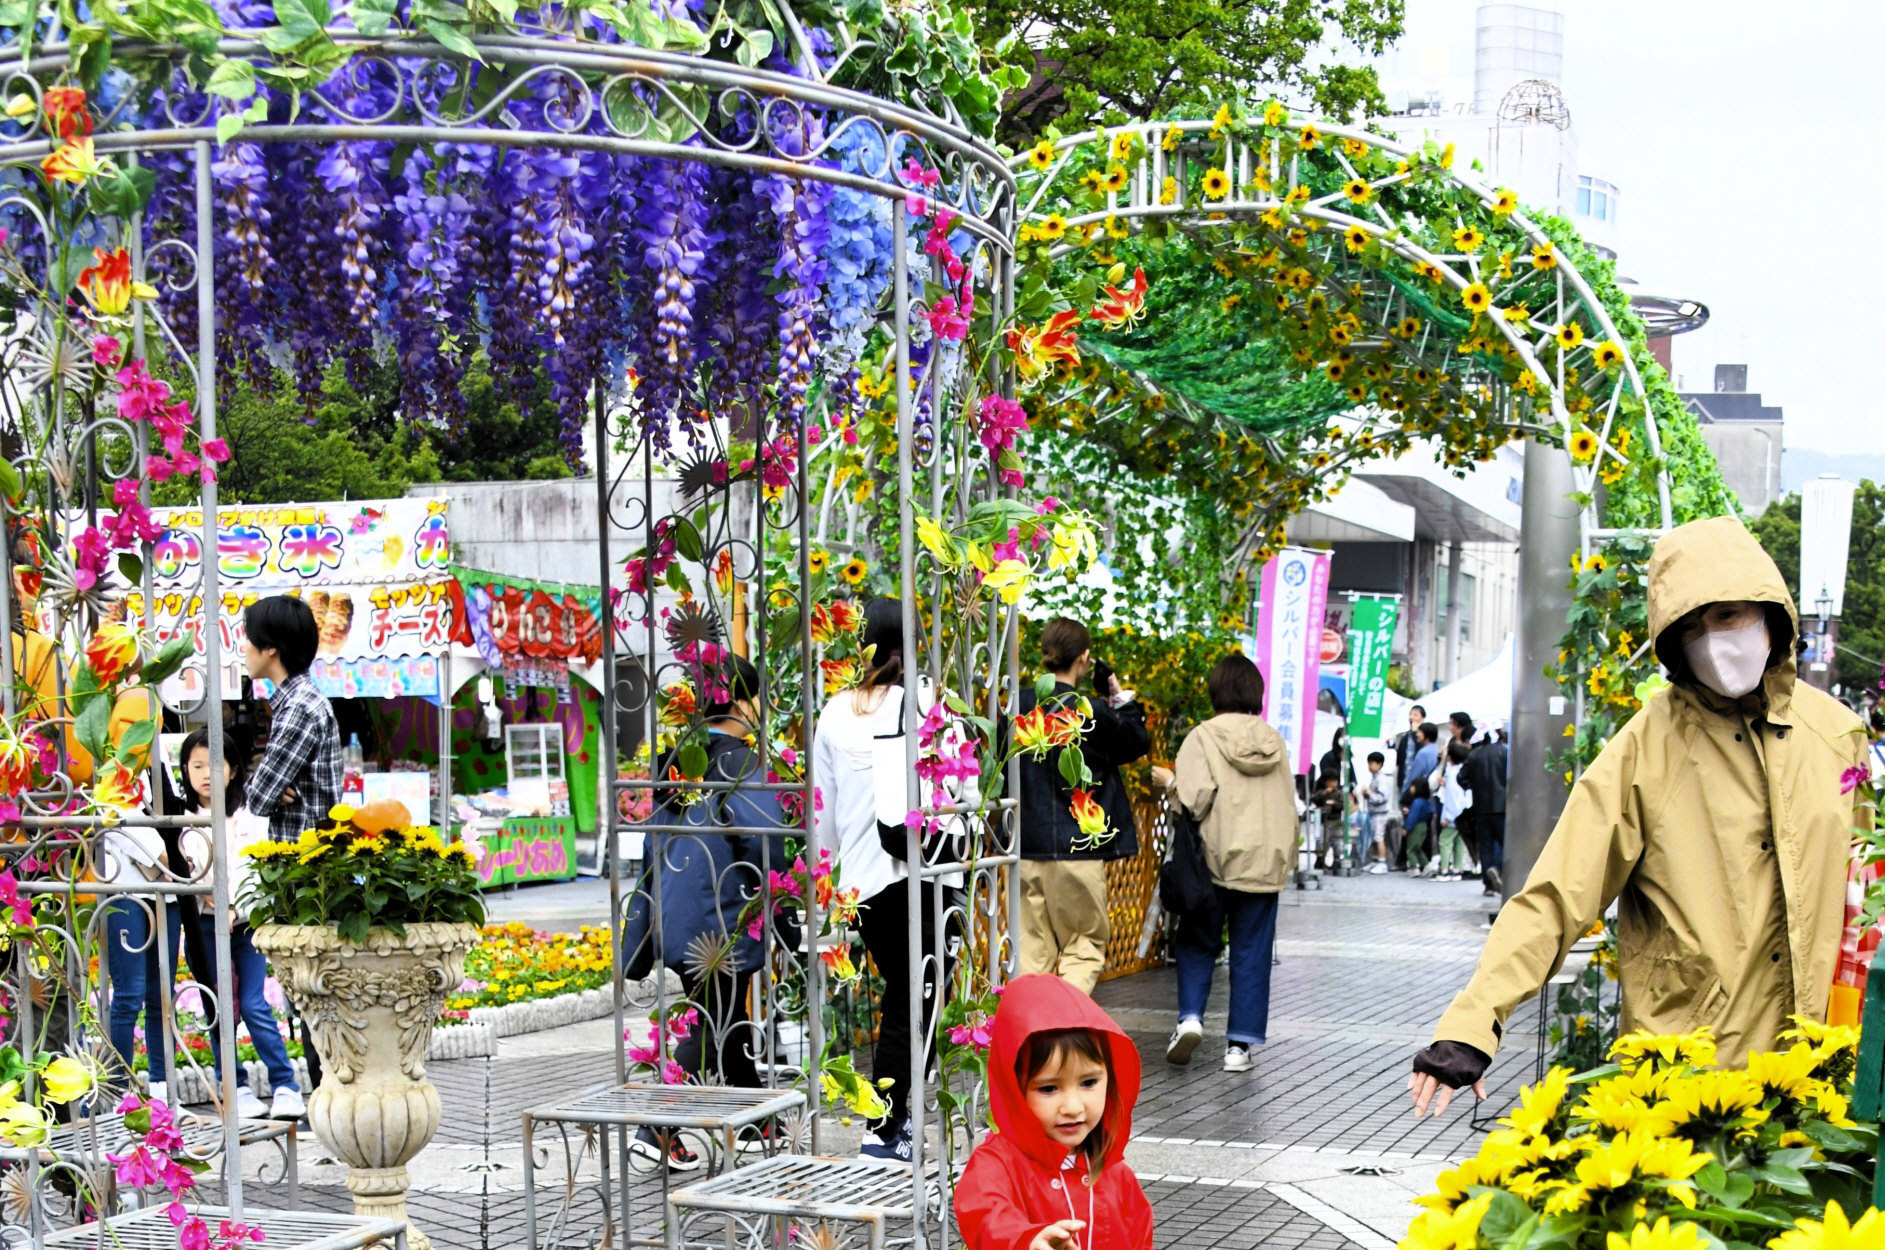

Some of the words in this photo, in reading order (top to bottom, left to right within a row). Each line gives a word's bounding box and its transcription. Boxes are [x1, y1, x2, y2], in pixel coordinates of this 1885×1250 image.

[152, 523, 342, 577] かき氷
[371, 605, 445, 649] チーズ
